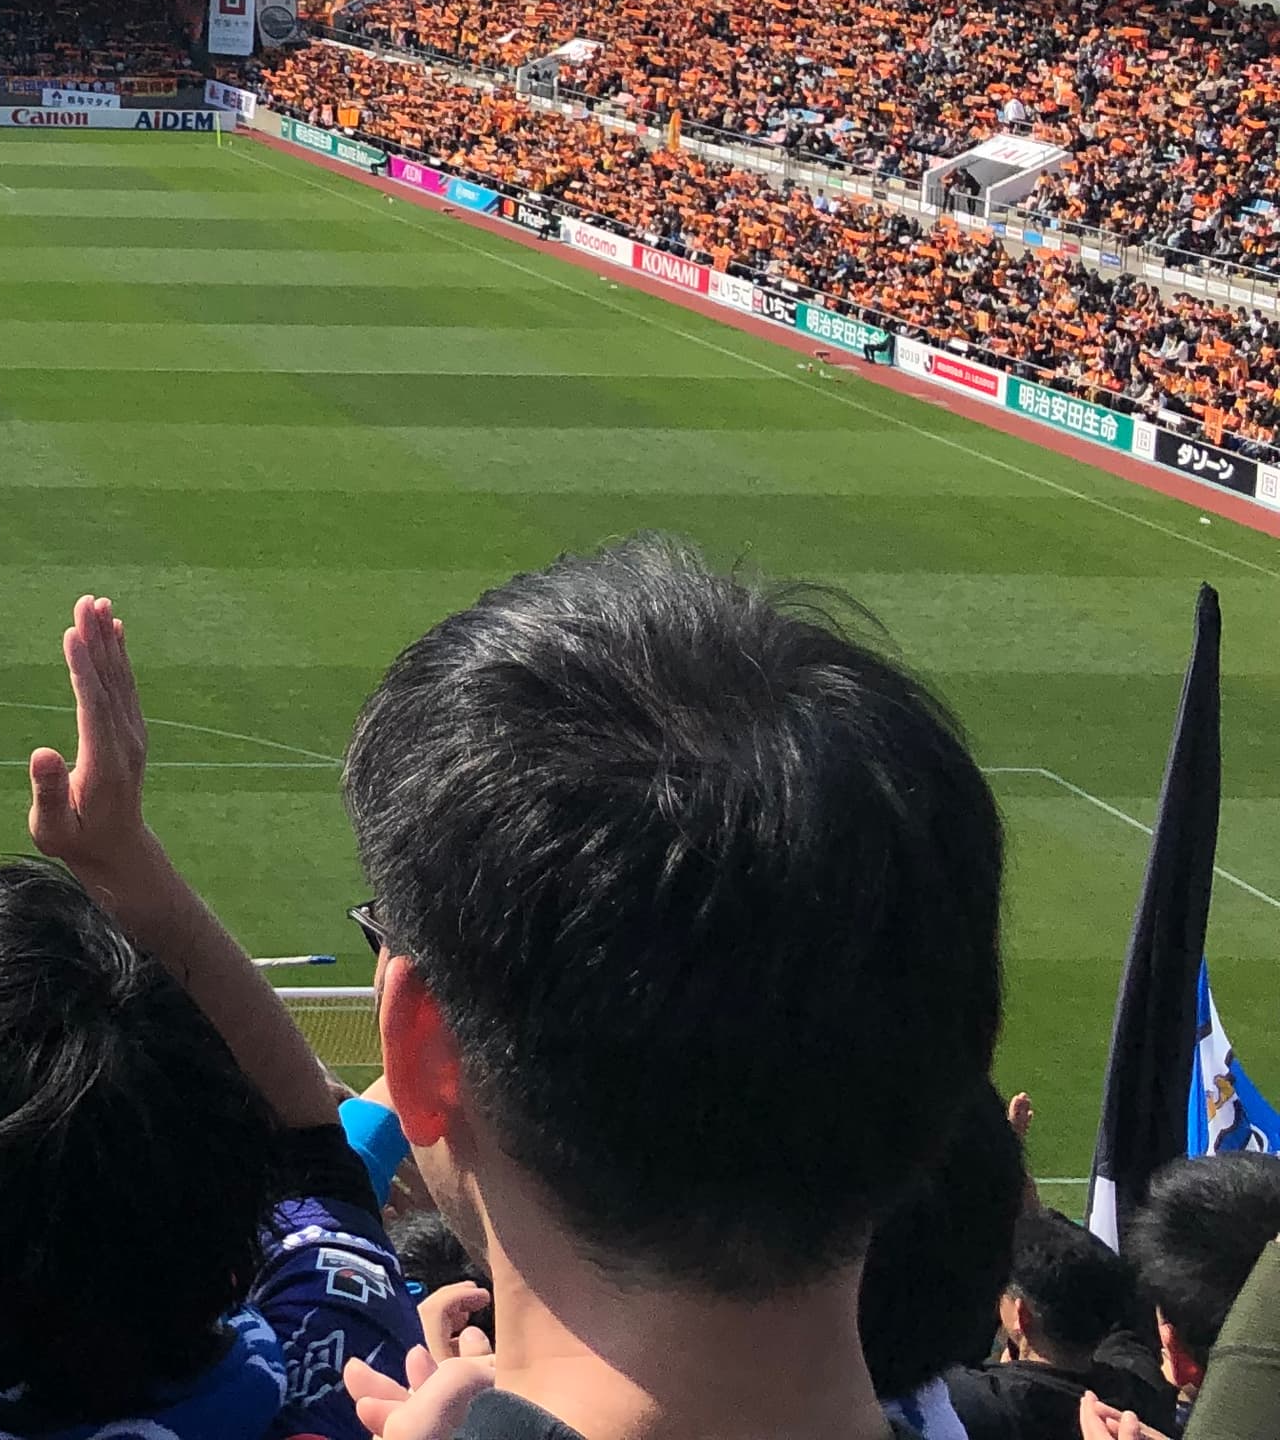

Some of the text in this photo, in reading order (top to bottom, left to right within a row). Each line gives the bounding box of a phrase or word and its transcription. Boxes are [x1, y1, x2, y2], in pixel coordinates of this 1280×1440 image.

[11, 109, 90, 126] Canon
[135, 111, 214, 131] AiDEM
[574, 227, 617, 258] docomo
[641, 249, 700, 289] KONAMI
[718, 277, 752, 306] いちご
[762, 296, 797, 325] いちご
[806, 307, 884, 348] 明治安田生命
[899, 347, 921, 365] 2019
[1017, 383, 1119, 442] 明治安田生命
